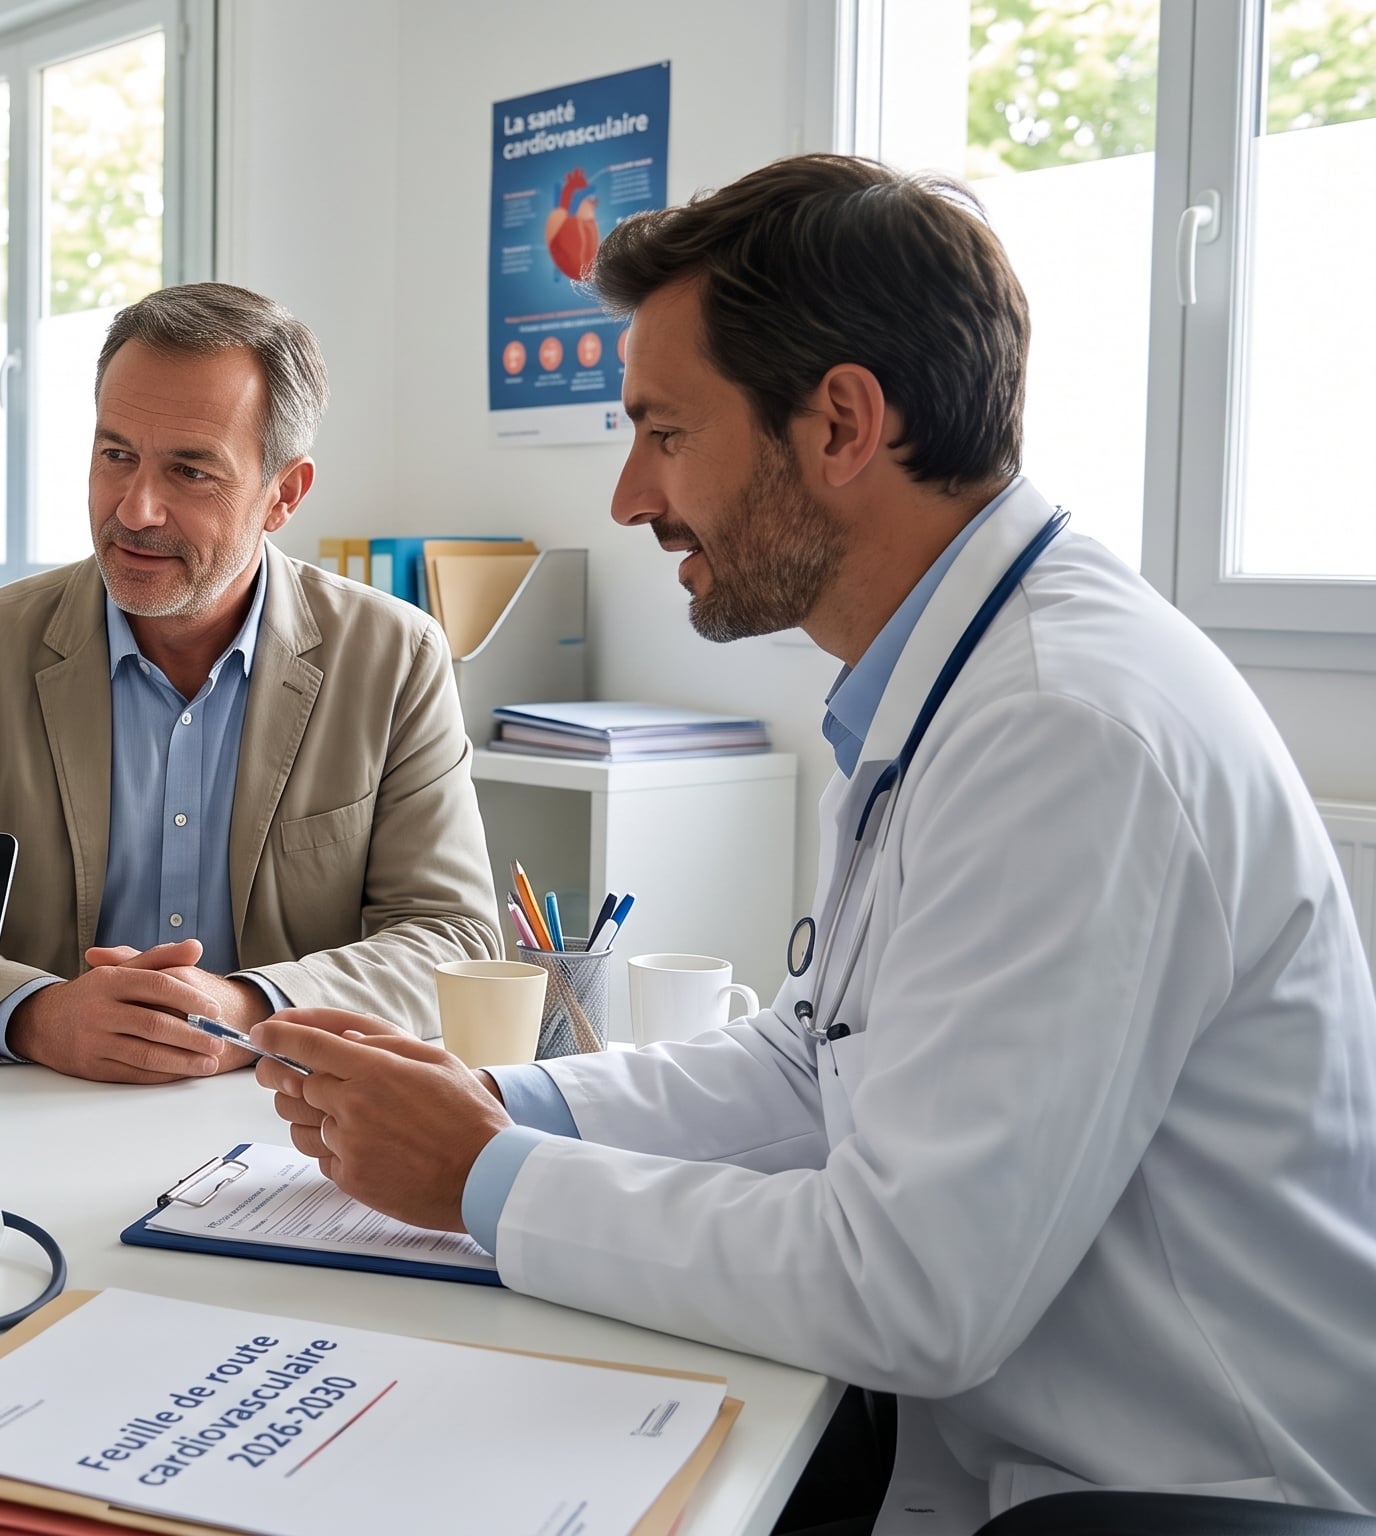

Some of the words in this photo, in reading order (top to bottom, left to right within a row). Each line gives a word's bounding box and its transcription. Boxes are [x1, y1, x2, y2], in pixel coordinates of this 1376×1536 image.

[502, 112, 650, 160] cardiovasculaire
[503, 115, 524, 137] La
[527, 99, 576, 132] santé
[77, 1410, 184, 1472] Feuille
[169, 1385, 216, 1411] de
[205, 1335, 280, 1384] route
[138, 1338, 338, 1487] cardiovasculaire
[227, 1375, 358, 1469] 2026-2030
